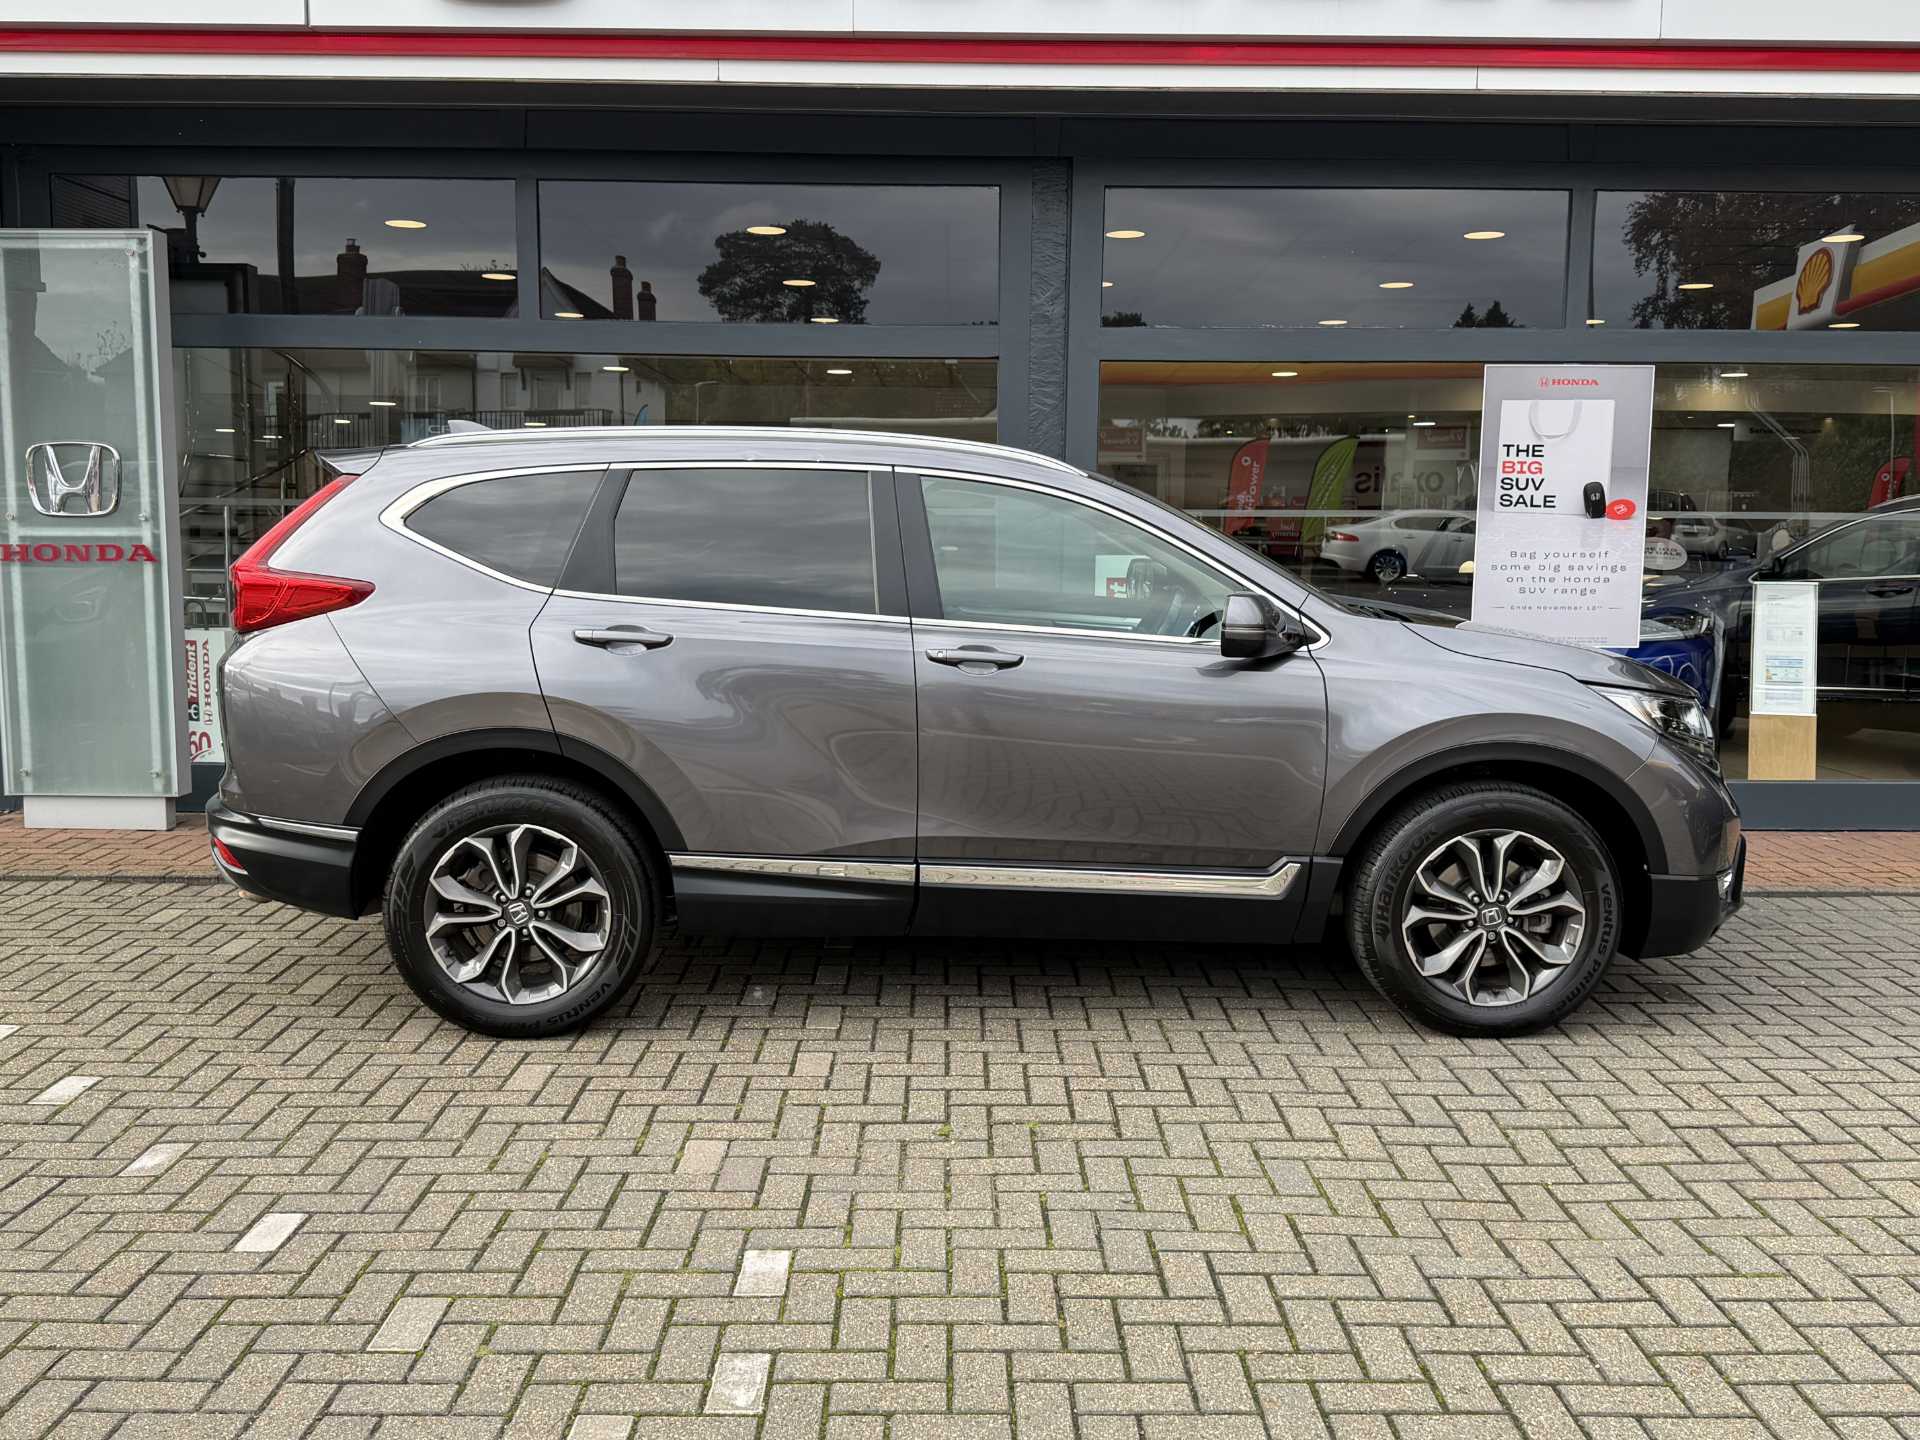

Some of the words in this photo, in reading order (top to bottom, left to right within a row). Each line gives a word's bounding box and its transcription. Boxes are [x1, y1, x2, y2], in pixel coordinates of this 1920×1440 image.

[1551, 378, 1599, 387] HONDA
[1502, 443, 1545, 458] THE
[1501, 460, 1543, 475] BIG
[1500, 477, 1545, 491] SUV
[1499, 493, 1557, 509] SALE
[0, 543, 160, 563] HONDA
[1510, 550, 1537, 560] Bag
[1543, 550, 1609, 560] yourself
[1538, 562, 1561, 573] big
[1567, 562, 1627, 574] savings
[1531, 575, 1556, 583] the
[1563, 575, 1611, 583] Honda
[1519, 586, 1547, 594] SUV
[1553, 587, 1597, 597] range
[186, 642, 198, 699] Trident
[202, 638, 212, 709] HONDA
